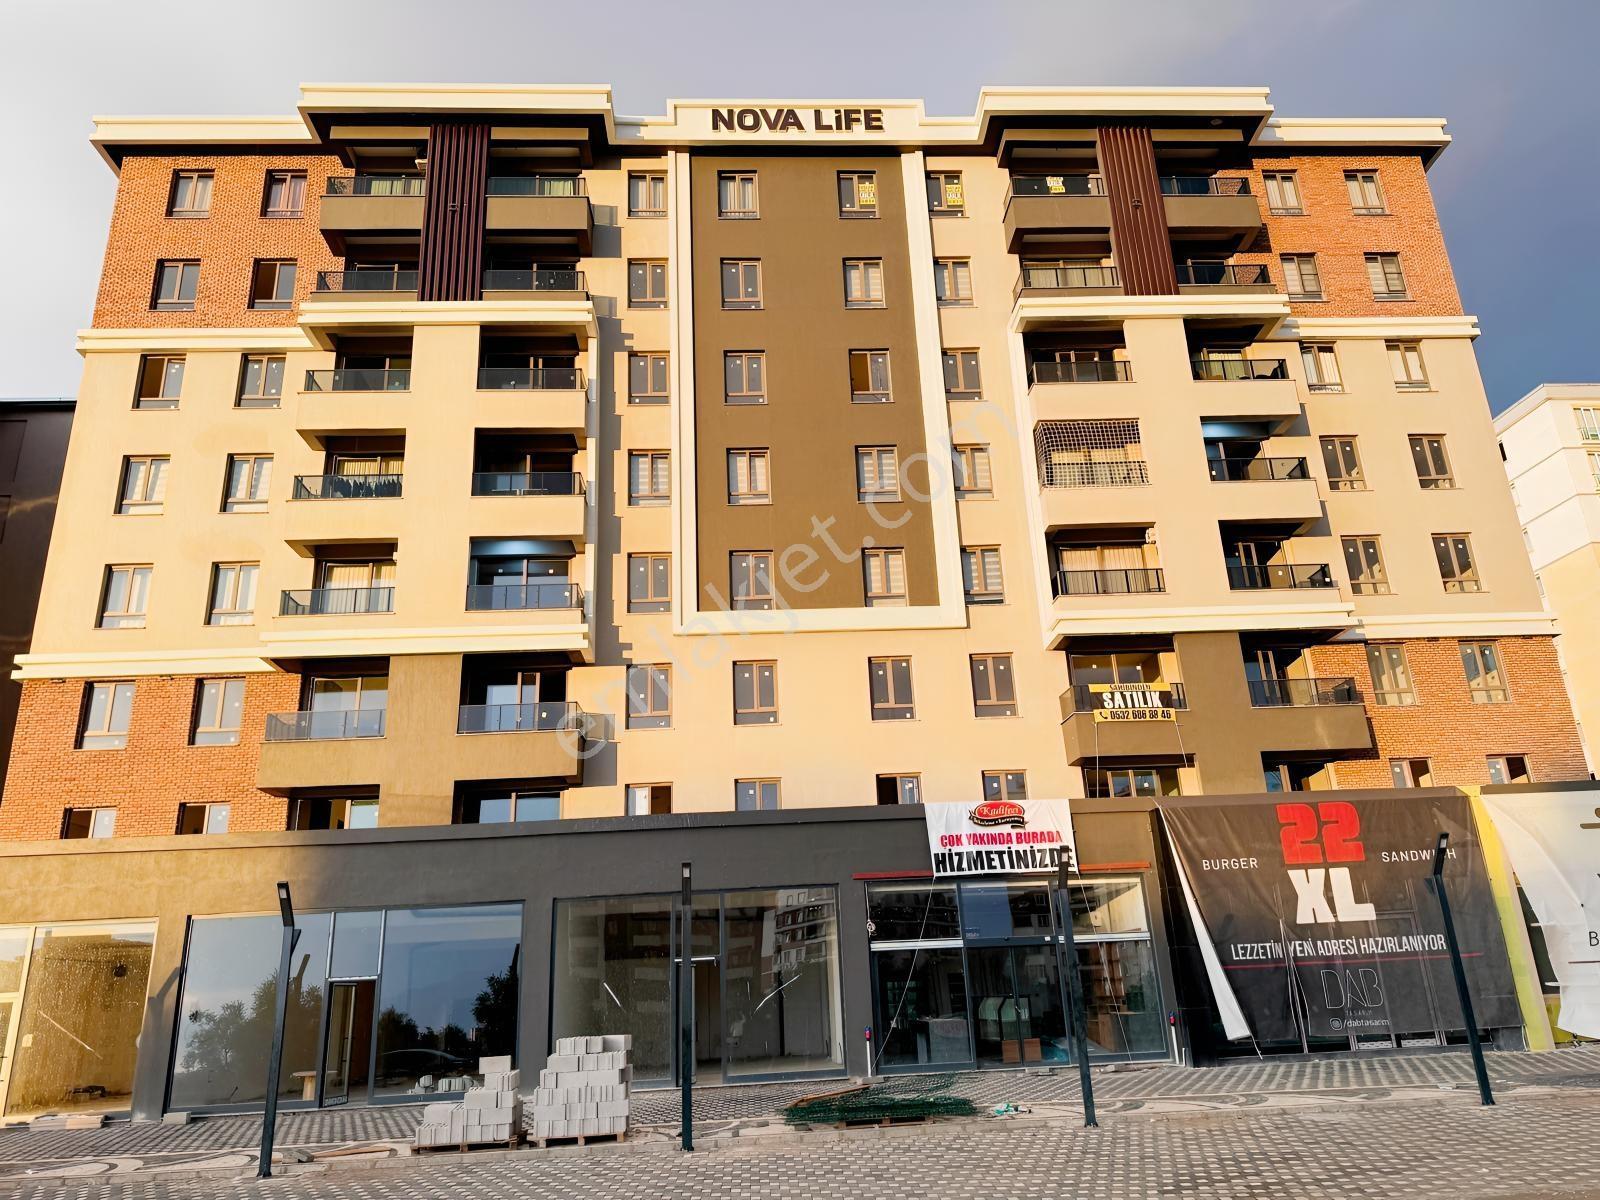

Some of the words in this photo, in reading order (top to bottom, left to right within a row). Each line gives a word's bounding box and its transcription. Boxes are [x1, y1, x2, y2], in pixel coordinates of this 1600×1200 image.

[712, 109, 806, 131] NOVA
[1102, 691, 1163, 709] SATILIK
[1110, 710, 1130, 720] 0532
[1161, 709, 1171, 719] 46
[940, 833, 962, 848] ÇOK
[965, 832, 1013, 846] YAKINDA
[1015, 831, 1062, 844] BURADA
[1276, 801, 1366, 865] 22
[1202, 857, 1259, 871] BURGER
[1382, 848, 1457, 863] SANDWIH
[1287, 867, 1376, 924] XL
[1231, 940, 1283, 960] LEZZETİN
[1287, 937, 1316, 957] YENİ
[1318, 936, 1358, 956] ADRESİ
[1360, 934, 1447, 954] HAZIRLANIYOR
[1321, 968, 1383, 1008] DAB
